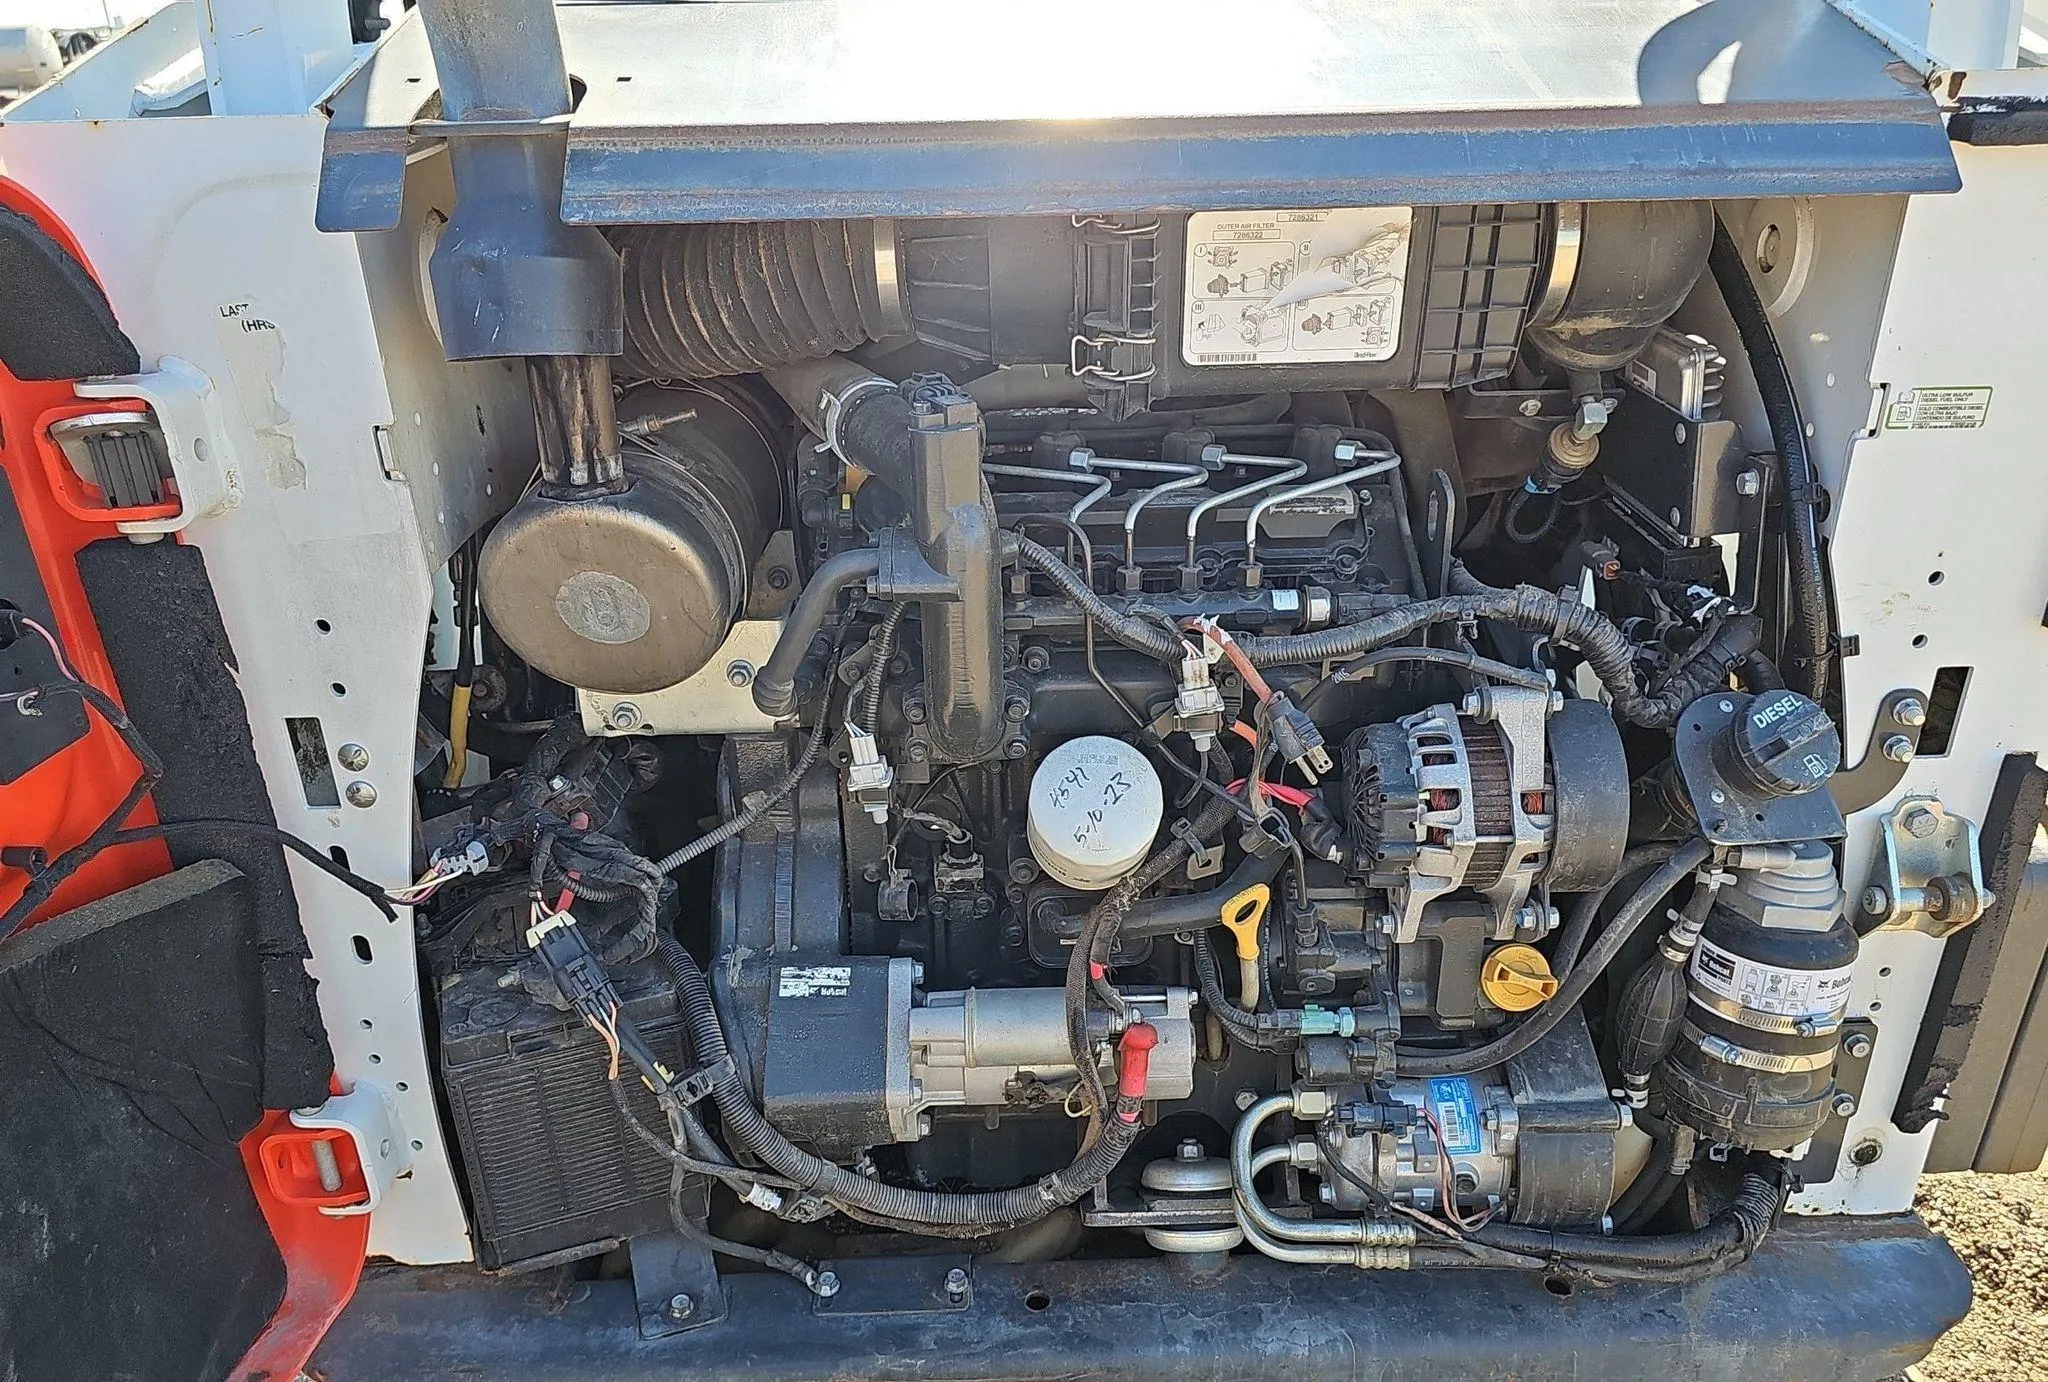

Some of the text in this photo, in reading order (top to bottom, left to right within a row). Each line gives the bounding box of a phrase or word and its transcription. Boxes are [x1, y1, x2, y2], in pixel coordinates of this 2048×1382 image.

[220, 303, 249, 317] LAST
[1753, 695, 1802, 728] DIESEL
[1709, 960, 1731, 977] Bobcat
[1501, 993, 1522, 1004] OPEN
